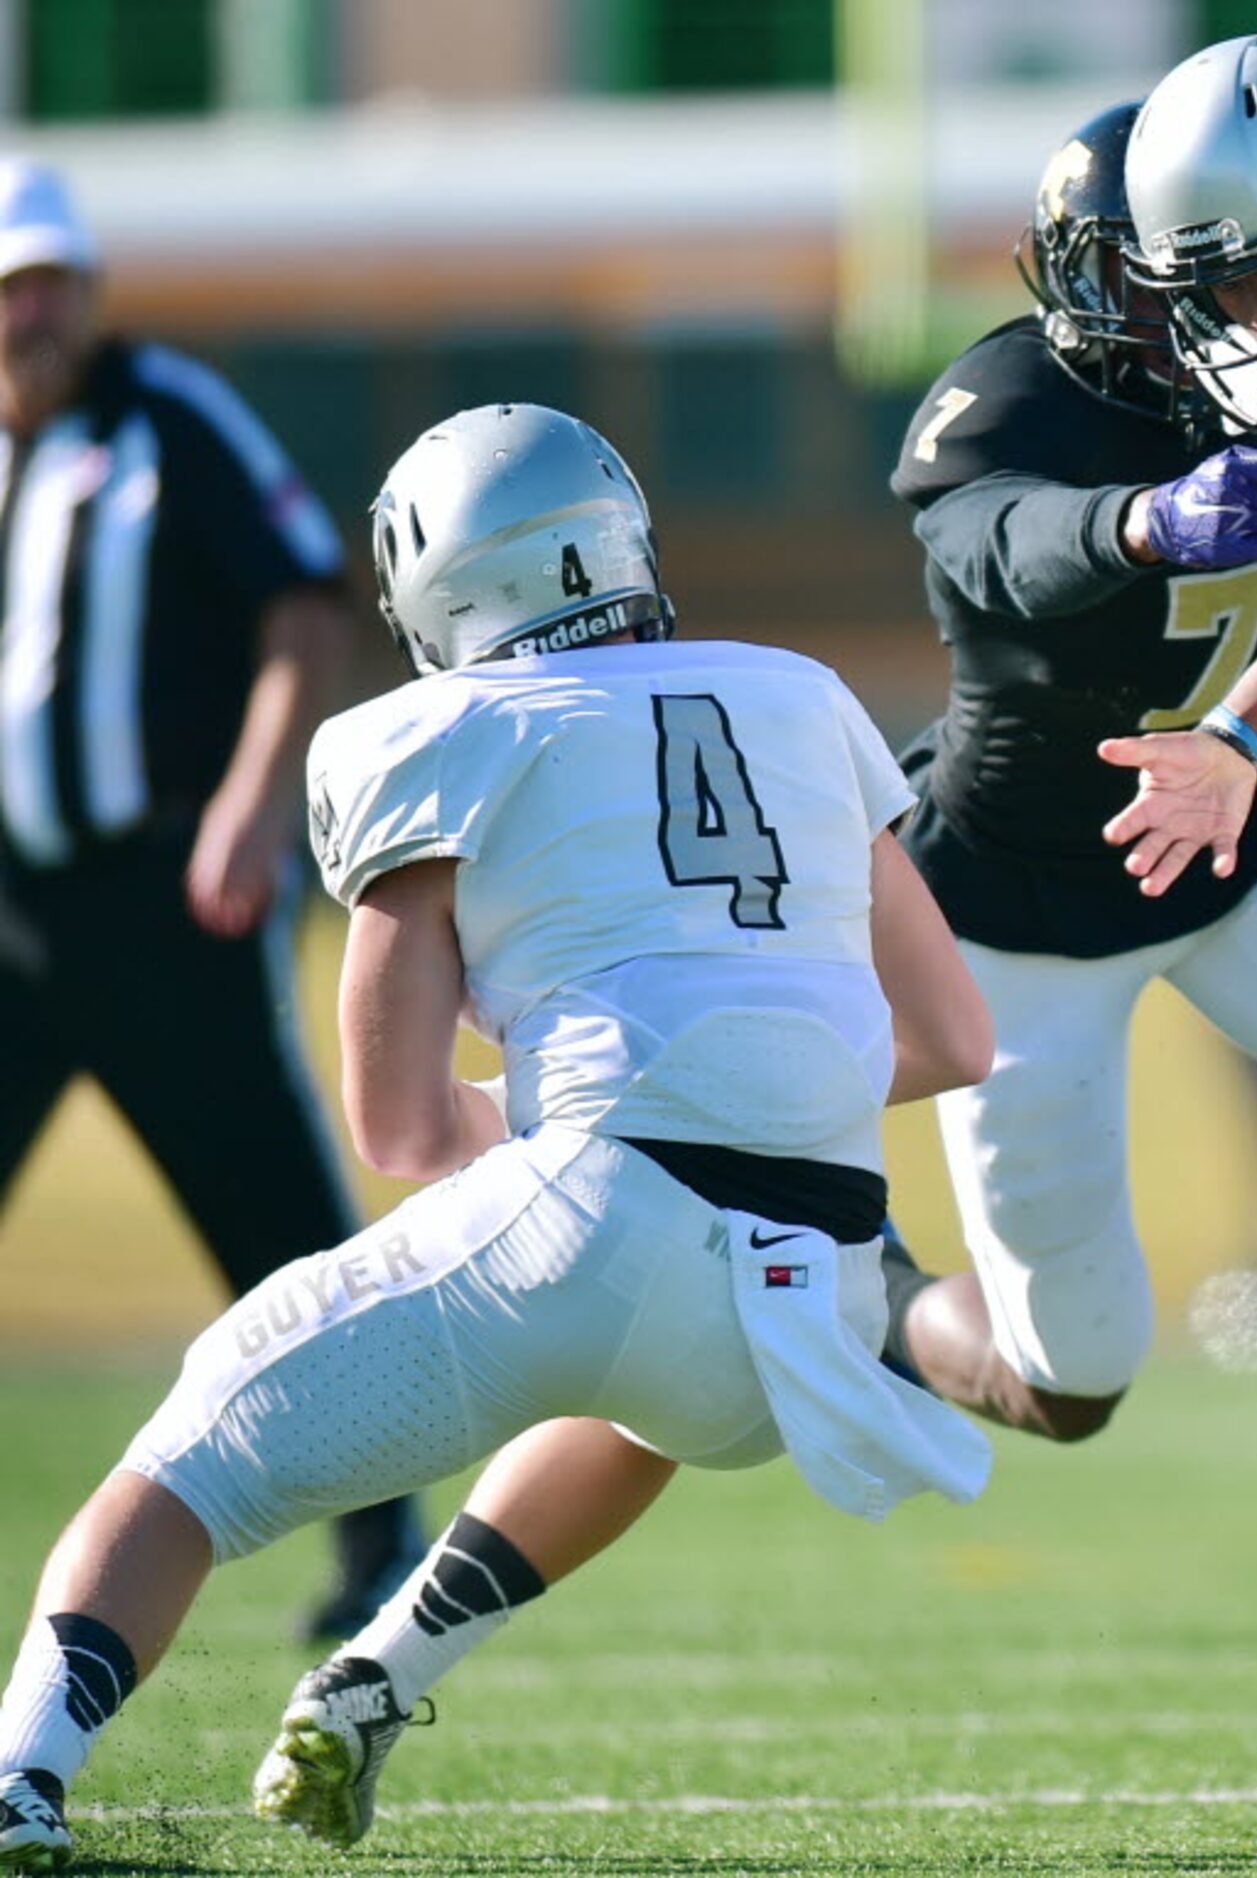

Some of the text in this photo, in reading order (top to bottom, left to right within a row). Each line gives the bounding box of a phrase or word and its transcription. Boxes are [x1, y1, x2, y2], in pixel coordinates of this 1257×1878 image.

[914, 388, 979, 463] 7
[562, 542, 592, 597] 4
[512, 603, 628, 659] Riddell
[651, 693, 791, 930] 4
[235, 1233, 427, 1359] GUYER
[325, 1680, 390, 1723] NIKE
